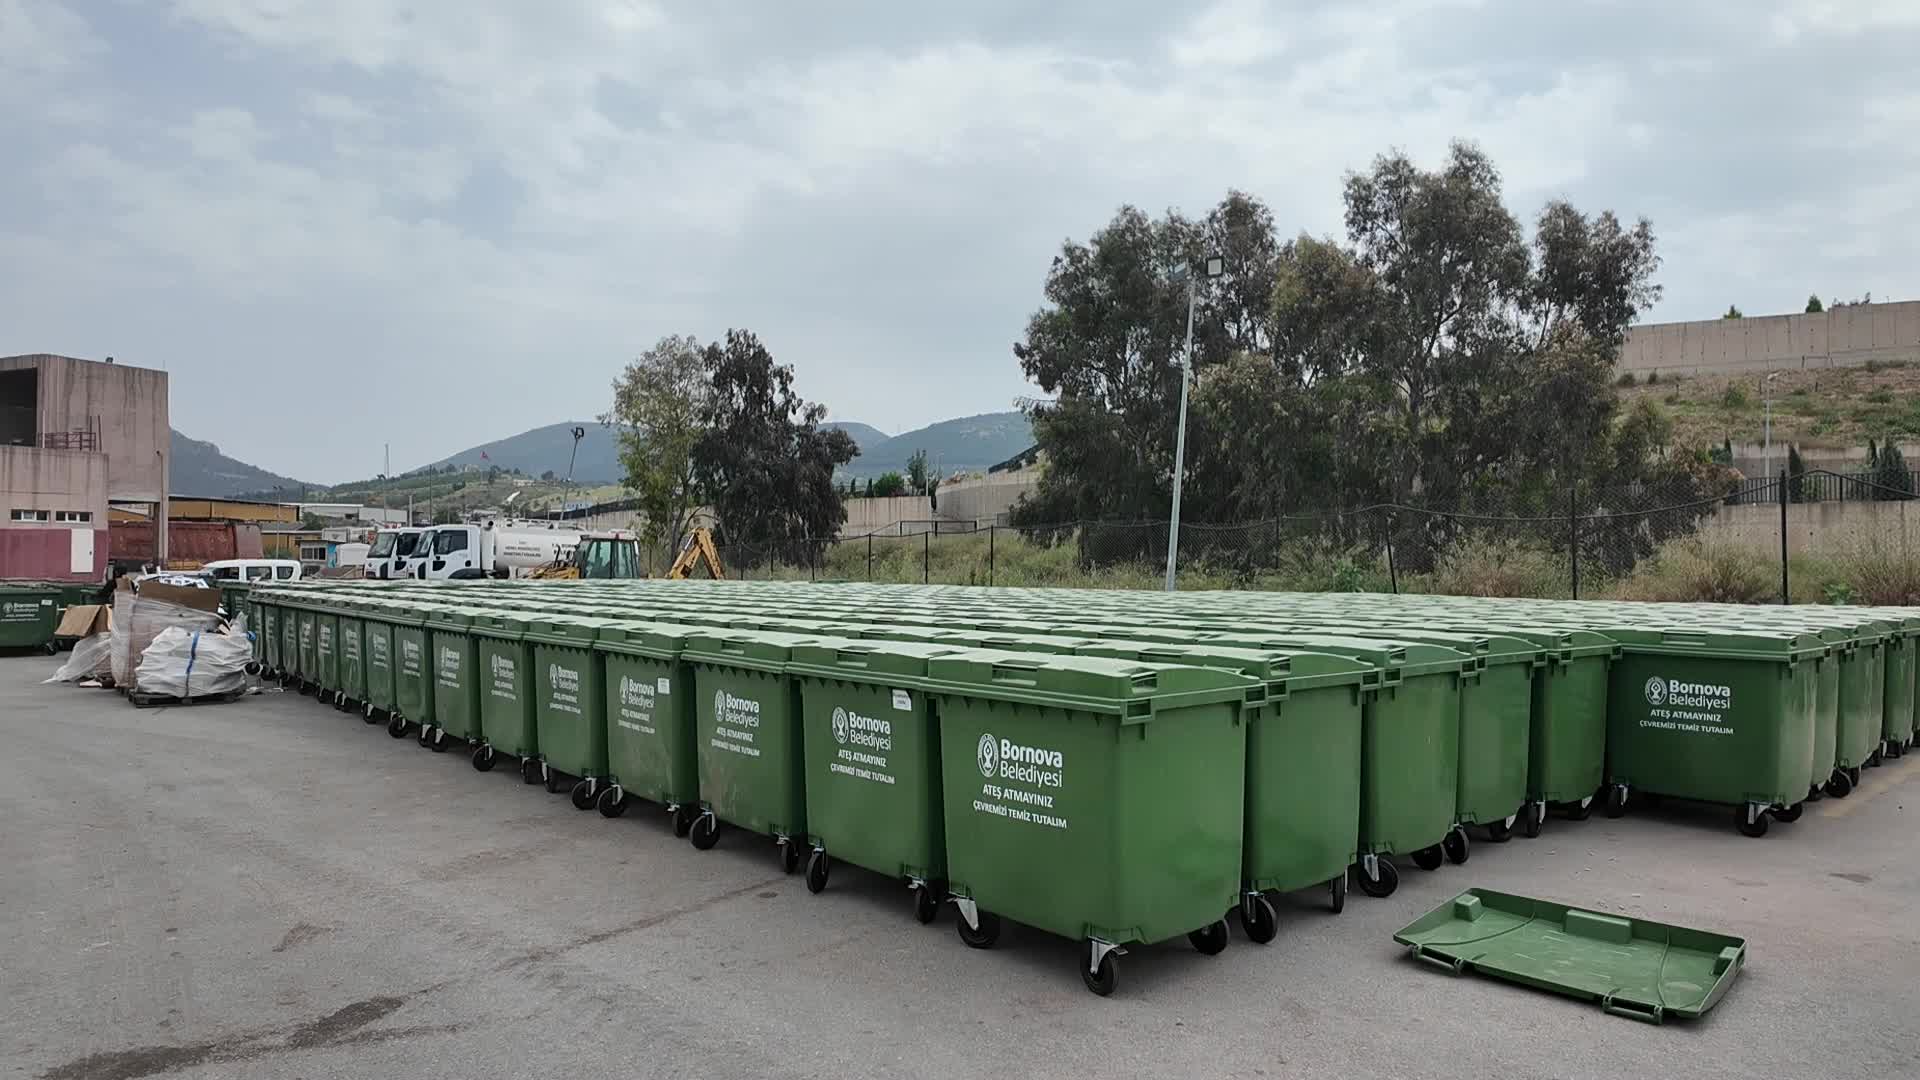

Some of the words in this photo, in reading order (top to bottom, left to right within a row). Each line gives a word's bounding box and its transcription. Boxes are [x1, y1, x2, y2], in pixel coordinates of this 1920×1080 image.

[1669, 680, 1731, 697] Bornova
[726, 693, 760, 713] Bornova
[1669, 693, 1731, 710] Belediyesi
[848, 711, 891, 735] Bornova
[1650, 709, 1671, 719] ATEŞ
[1672, 711, 1722, 722] ATMAYINIZ
[1677, 723, 1700, 732] TEMİZ
[1701, 725, 1734, 735] TUTALIM
[850, 729, 892, 752] Belediyesi
[838, 749, 852, 762] ATEŞ
[1000, 738, 1063, 768] Bornova
[1000, 760, 1063, 788] Belediyesi
[982, 784, 1002, 800] ATEŞ
[1003, 788, 1054, 808] ATMAYINIZ
[973, 799, 1008, 817] ÇEVREMİZİ
[1008, 808, 1031, 822] TEMİZ
[1032, 813, 1068, 828] TUTALIM
